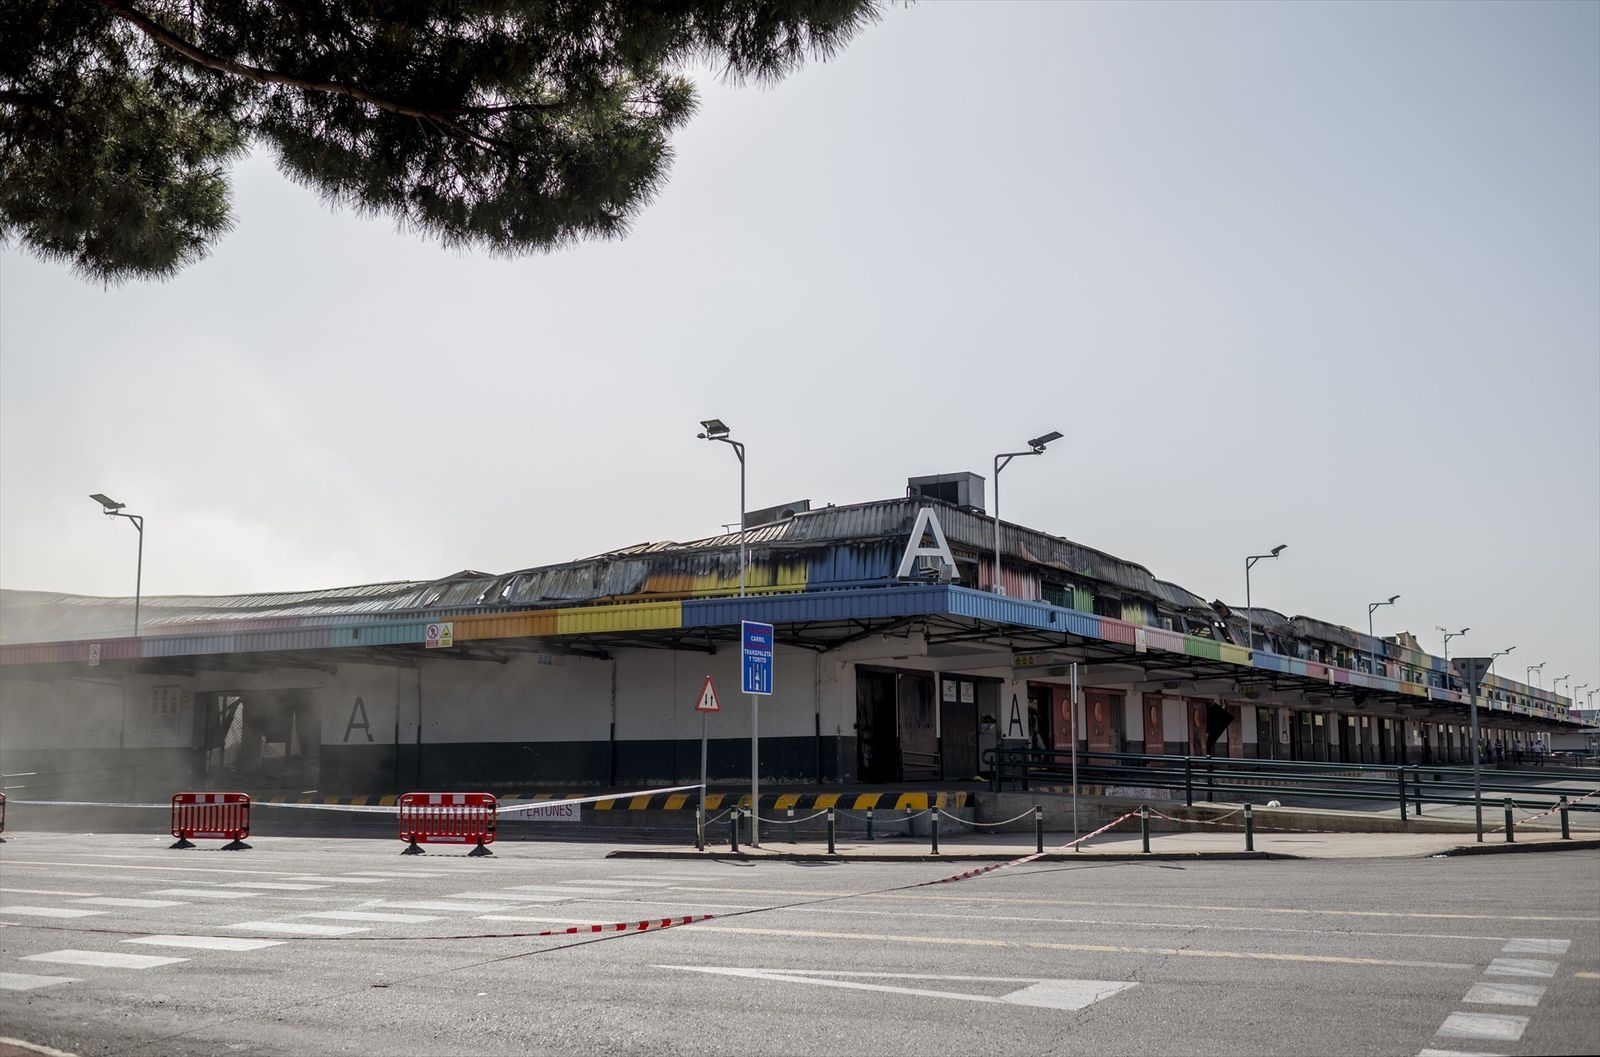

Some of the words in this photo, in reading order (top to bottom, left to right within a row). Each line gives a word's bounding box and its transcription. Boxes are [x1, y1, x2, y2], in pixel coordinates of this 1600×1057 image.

[896, 507, 961, 582] A
[744, 649, 772, 657] TRANSPALETA
[751, 635, 766, 643] CARRIL
[343, 696, 374, 743] A
[1008, 693, 1024, 737] A
